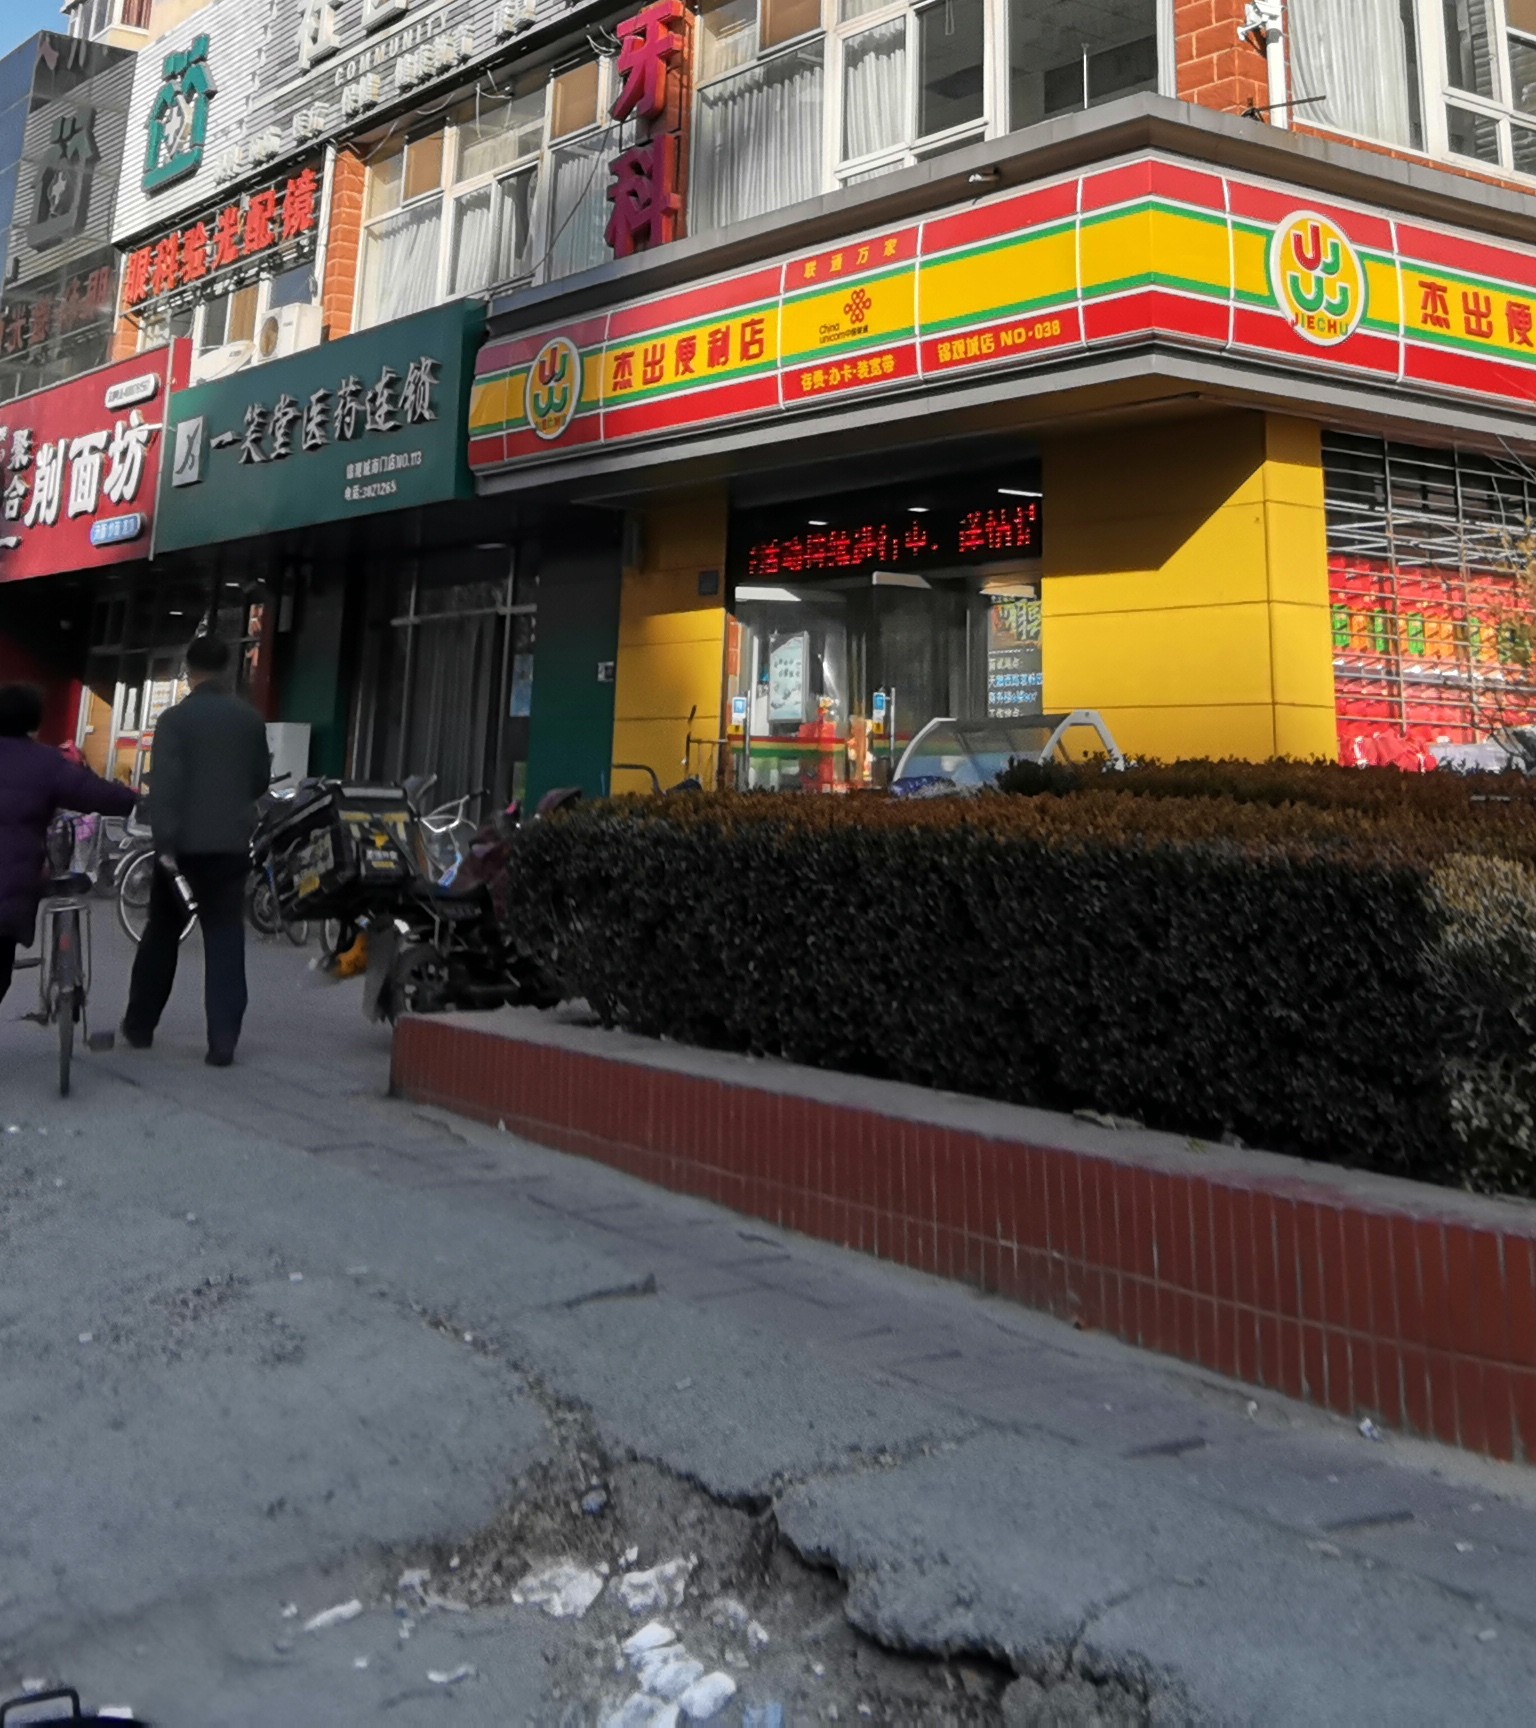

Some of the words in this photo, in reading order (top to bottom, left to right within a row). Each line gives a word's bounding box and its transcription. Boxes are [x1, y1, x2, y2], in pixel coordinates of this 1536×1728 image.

[124, 168, 318, 305] 眼科验光配镜
[804, 238, 898, 280] 联通万家
[611, 318, 765, 392] 杰出便利店
[1290, 312, 1349, 336] JIECHU
[210, 355, 443, 465] 一笑堂医药连锁
[23, 409, 158, 528] 削面坊
